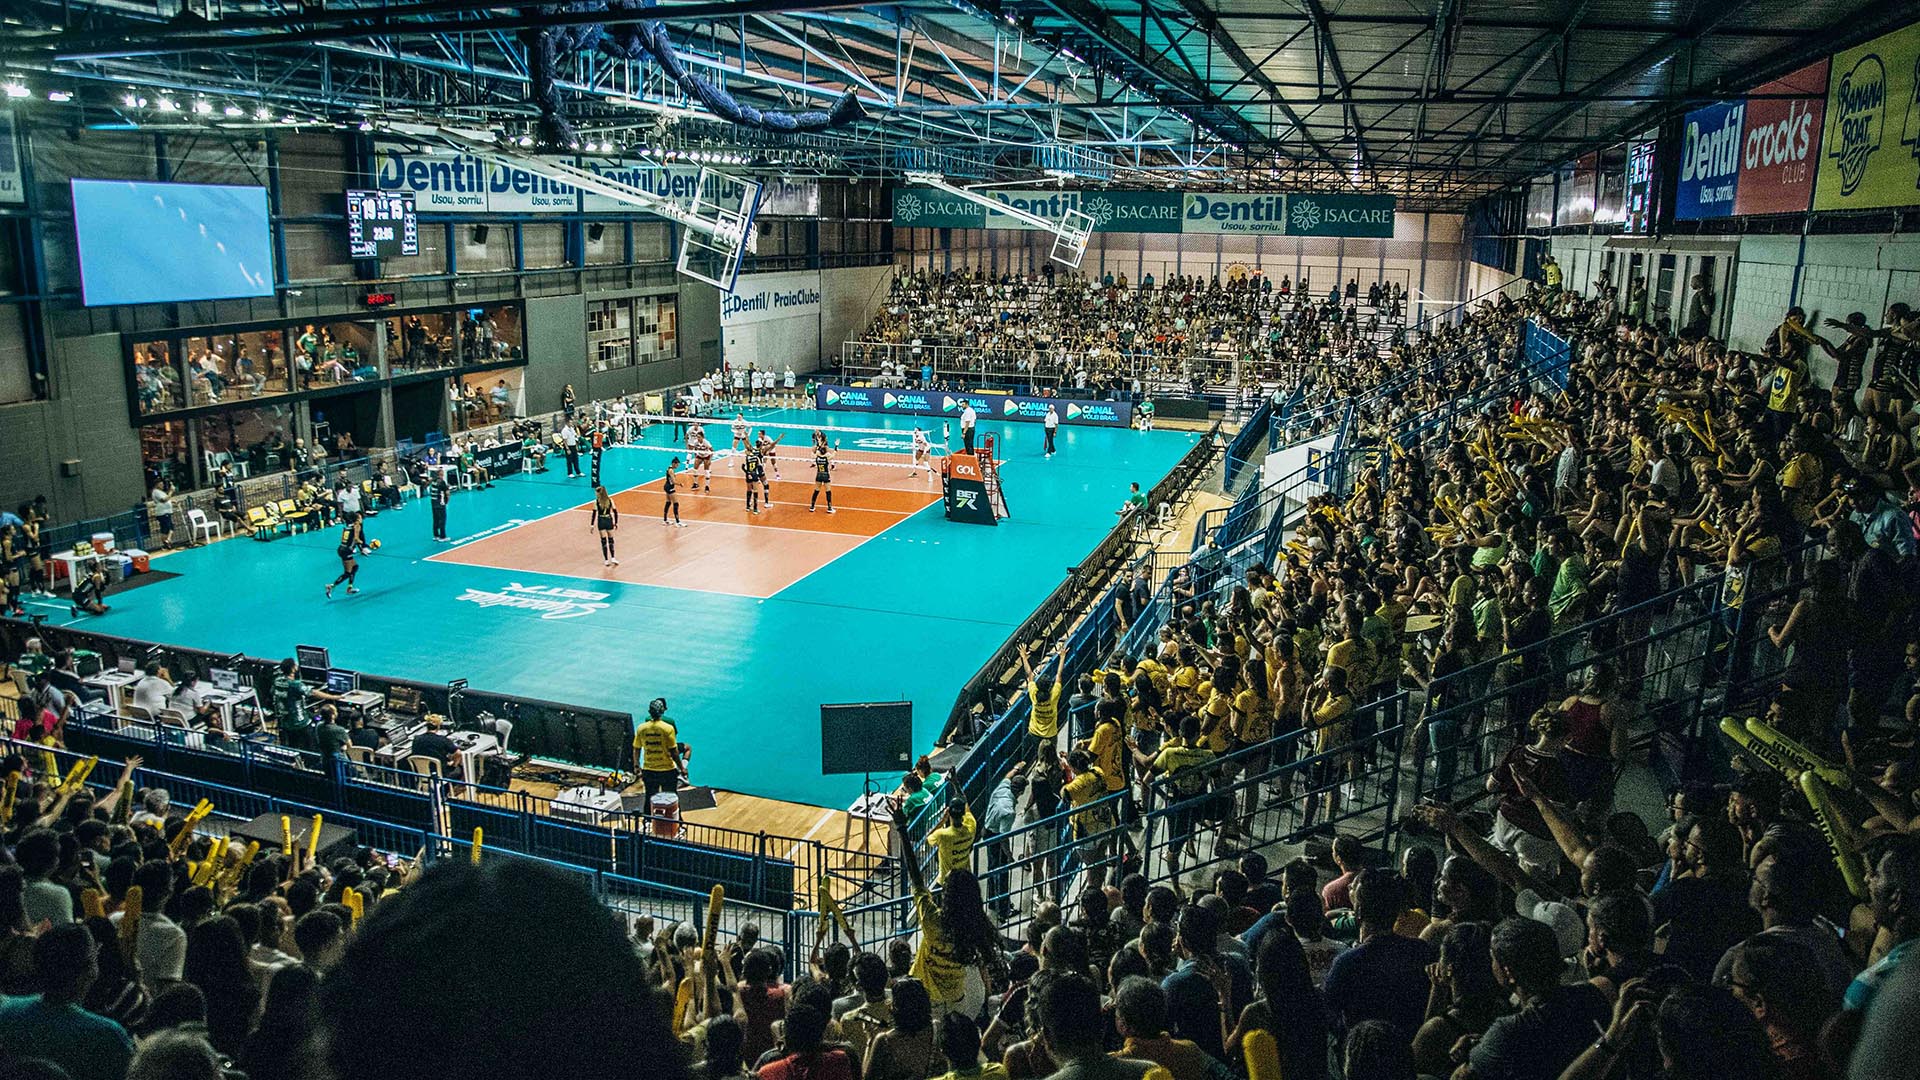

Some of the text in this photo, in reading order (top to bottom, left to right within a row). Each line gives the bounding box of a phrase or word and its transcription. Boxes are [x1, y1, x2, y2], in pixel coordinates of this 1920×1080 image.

[1839, 80, 1883, 123] BANANA
[1682, 104, 1744, 181] Dentil
[381, 148, 483, 192] Dentil
[1782, 163, 1806, 184] CLUB
[431, 194, 484, 206] Usou, sorriu.
[531, 196, 575, 207] Usou, sorriu.
[924, 202, 981, 216] ISACARE
[1116, 205, 1178, 220] ISACARE
[1187, 195, 1282, 222] Dentil
[1324, 208, 1391, 224] ISACARE
[1221, 222, 1281, 232] Usou, sorriu.
[774, 288, 820, 308] PraiaClube
[840, 391, 868, 401] CANAL
[897, 394, 927, 404] CANAL
[1019, 402, 1050, 411] CANAL
[1082, 405, 1114, 415] CANAL
[956, 465, 976, 476] GOL
[956, 489, 979, 499] BET
[956, 497, 978, 511] 7K
